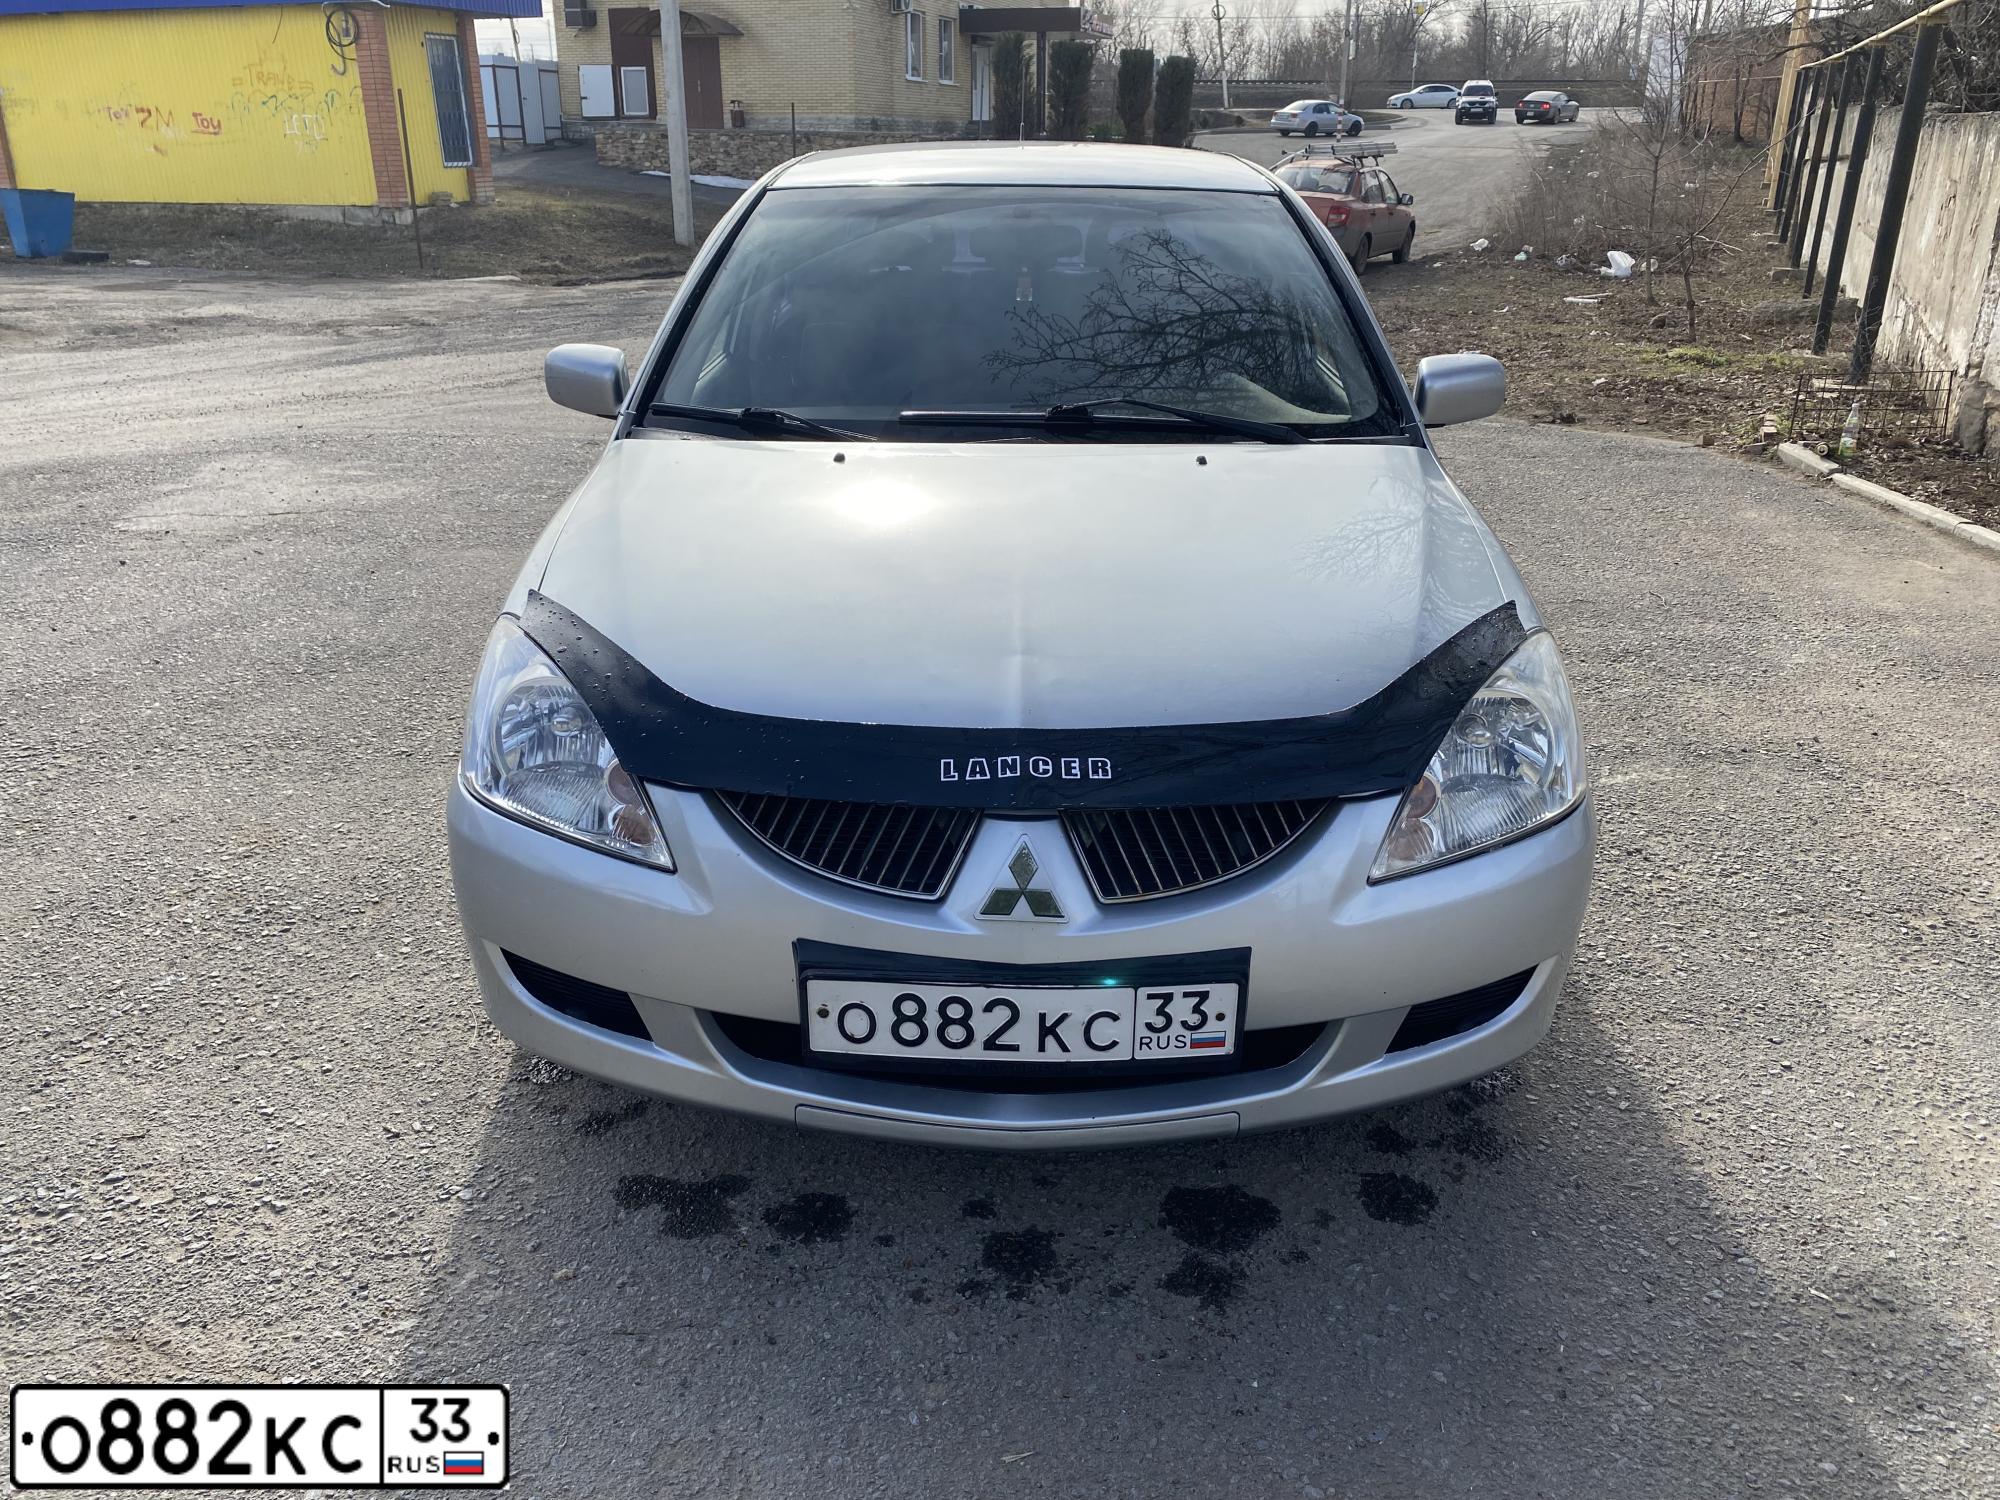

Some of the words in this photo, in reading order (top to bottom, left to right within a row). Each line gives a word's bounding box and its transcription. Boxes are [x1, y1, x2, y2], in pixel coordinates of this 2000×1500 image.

[941, 755, 1112, 782] LANCER
[1144, 990, 1210, 1034] 33
[1138, 1034, 1187, 1051] RUS
